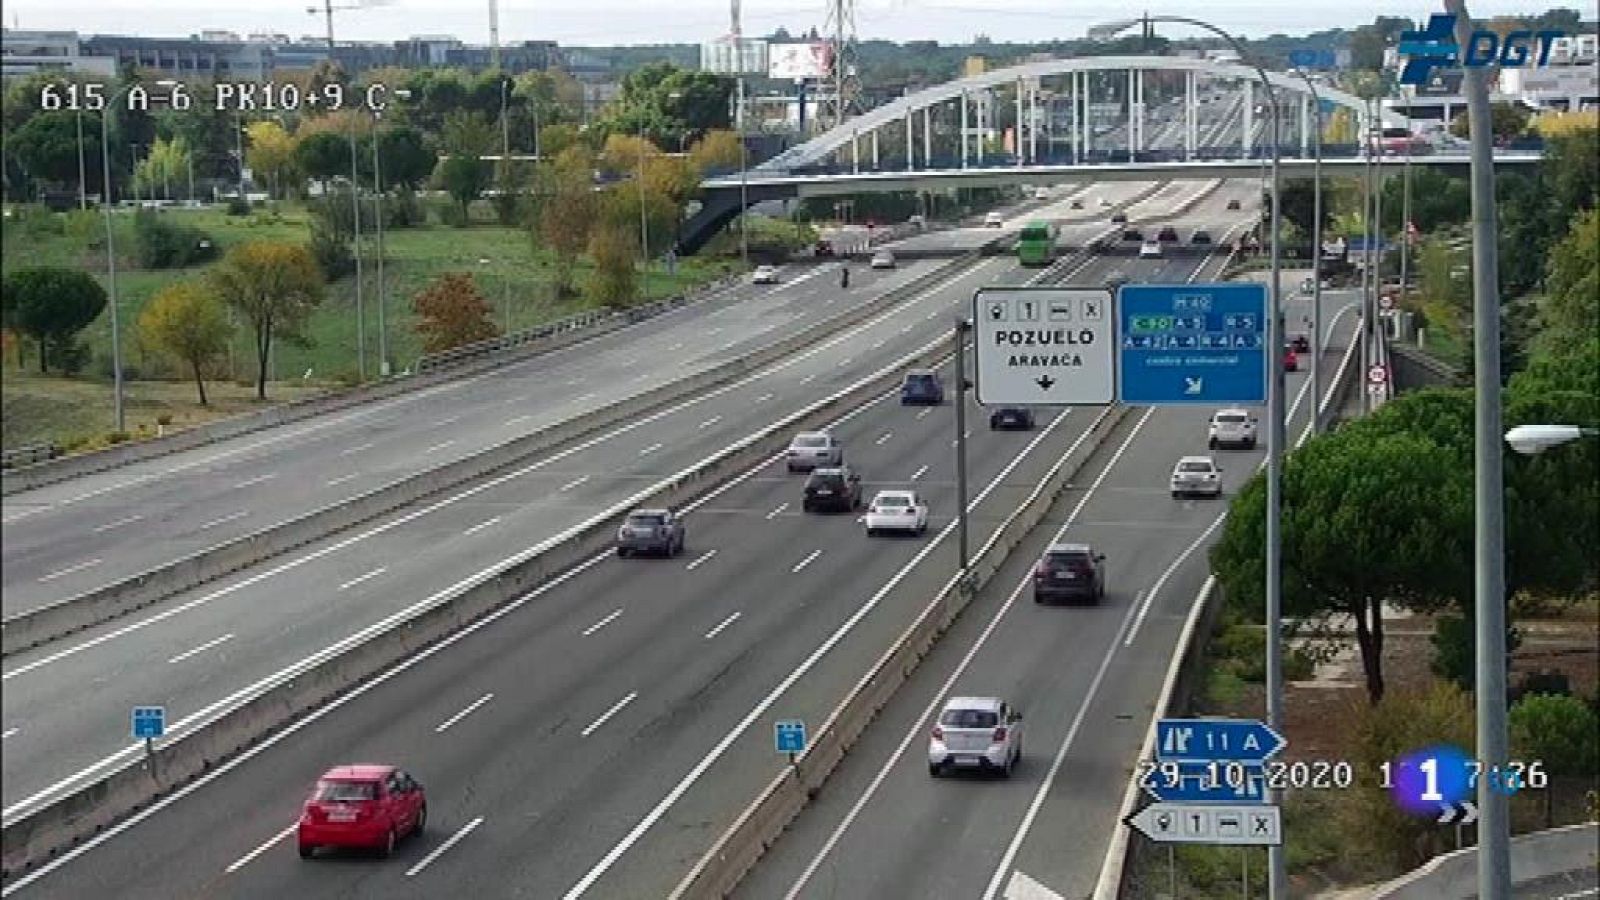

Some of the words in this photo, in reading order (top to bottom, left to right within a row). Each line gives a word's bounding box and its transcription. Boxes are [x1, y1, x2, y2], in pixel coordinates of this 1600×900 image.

[995, 330, 1095, 346] POZUELO
[1206, 731, 1229, 751] 11
[1243, 733, 1261, 751] A
